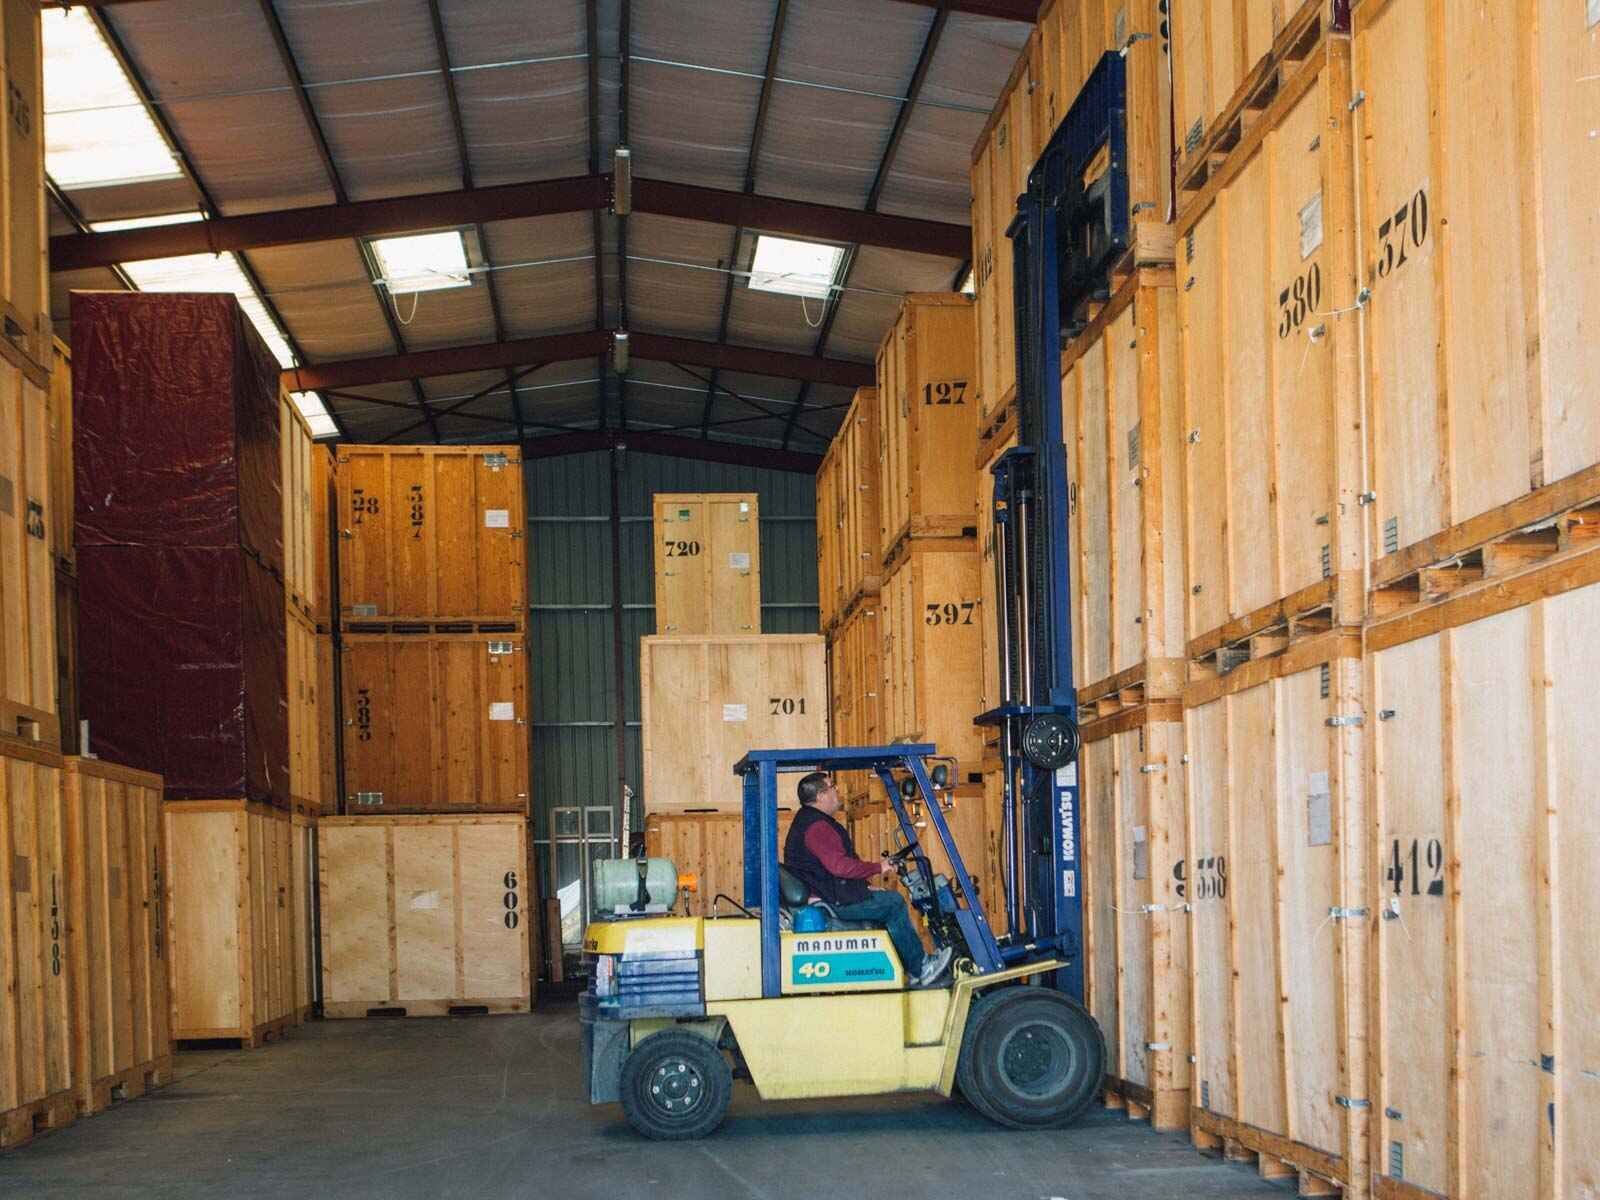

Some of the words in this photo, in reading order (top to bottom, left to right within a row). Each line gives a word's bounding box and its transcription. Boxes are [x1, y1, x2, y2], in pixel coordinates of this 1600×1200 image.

[1379, 190, 1427, 279] 370
[1279, 262, 1320, 339] 380
[923, 382, 967, 405] 127
[665, 541, 700, 557] 720
[926, 603, 974, 626] 397
[769, 698, 806, 715] 701
[1059, 792, 1074, 861] KOMATSU
[1387, 838, 1444, 896] 412
[503, 871, 518, 929] 600
[797, 938, 877, 952] MANUMAT
[799, 962, 830, 978] 40
